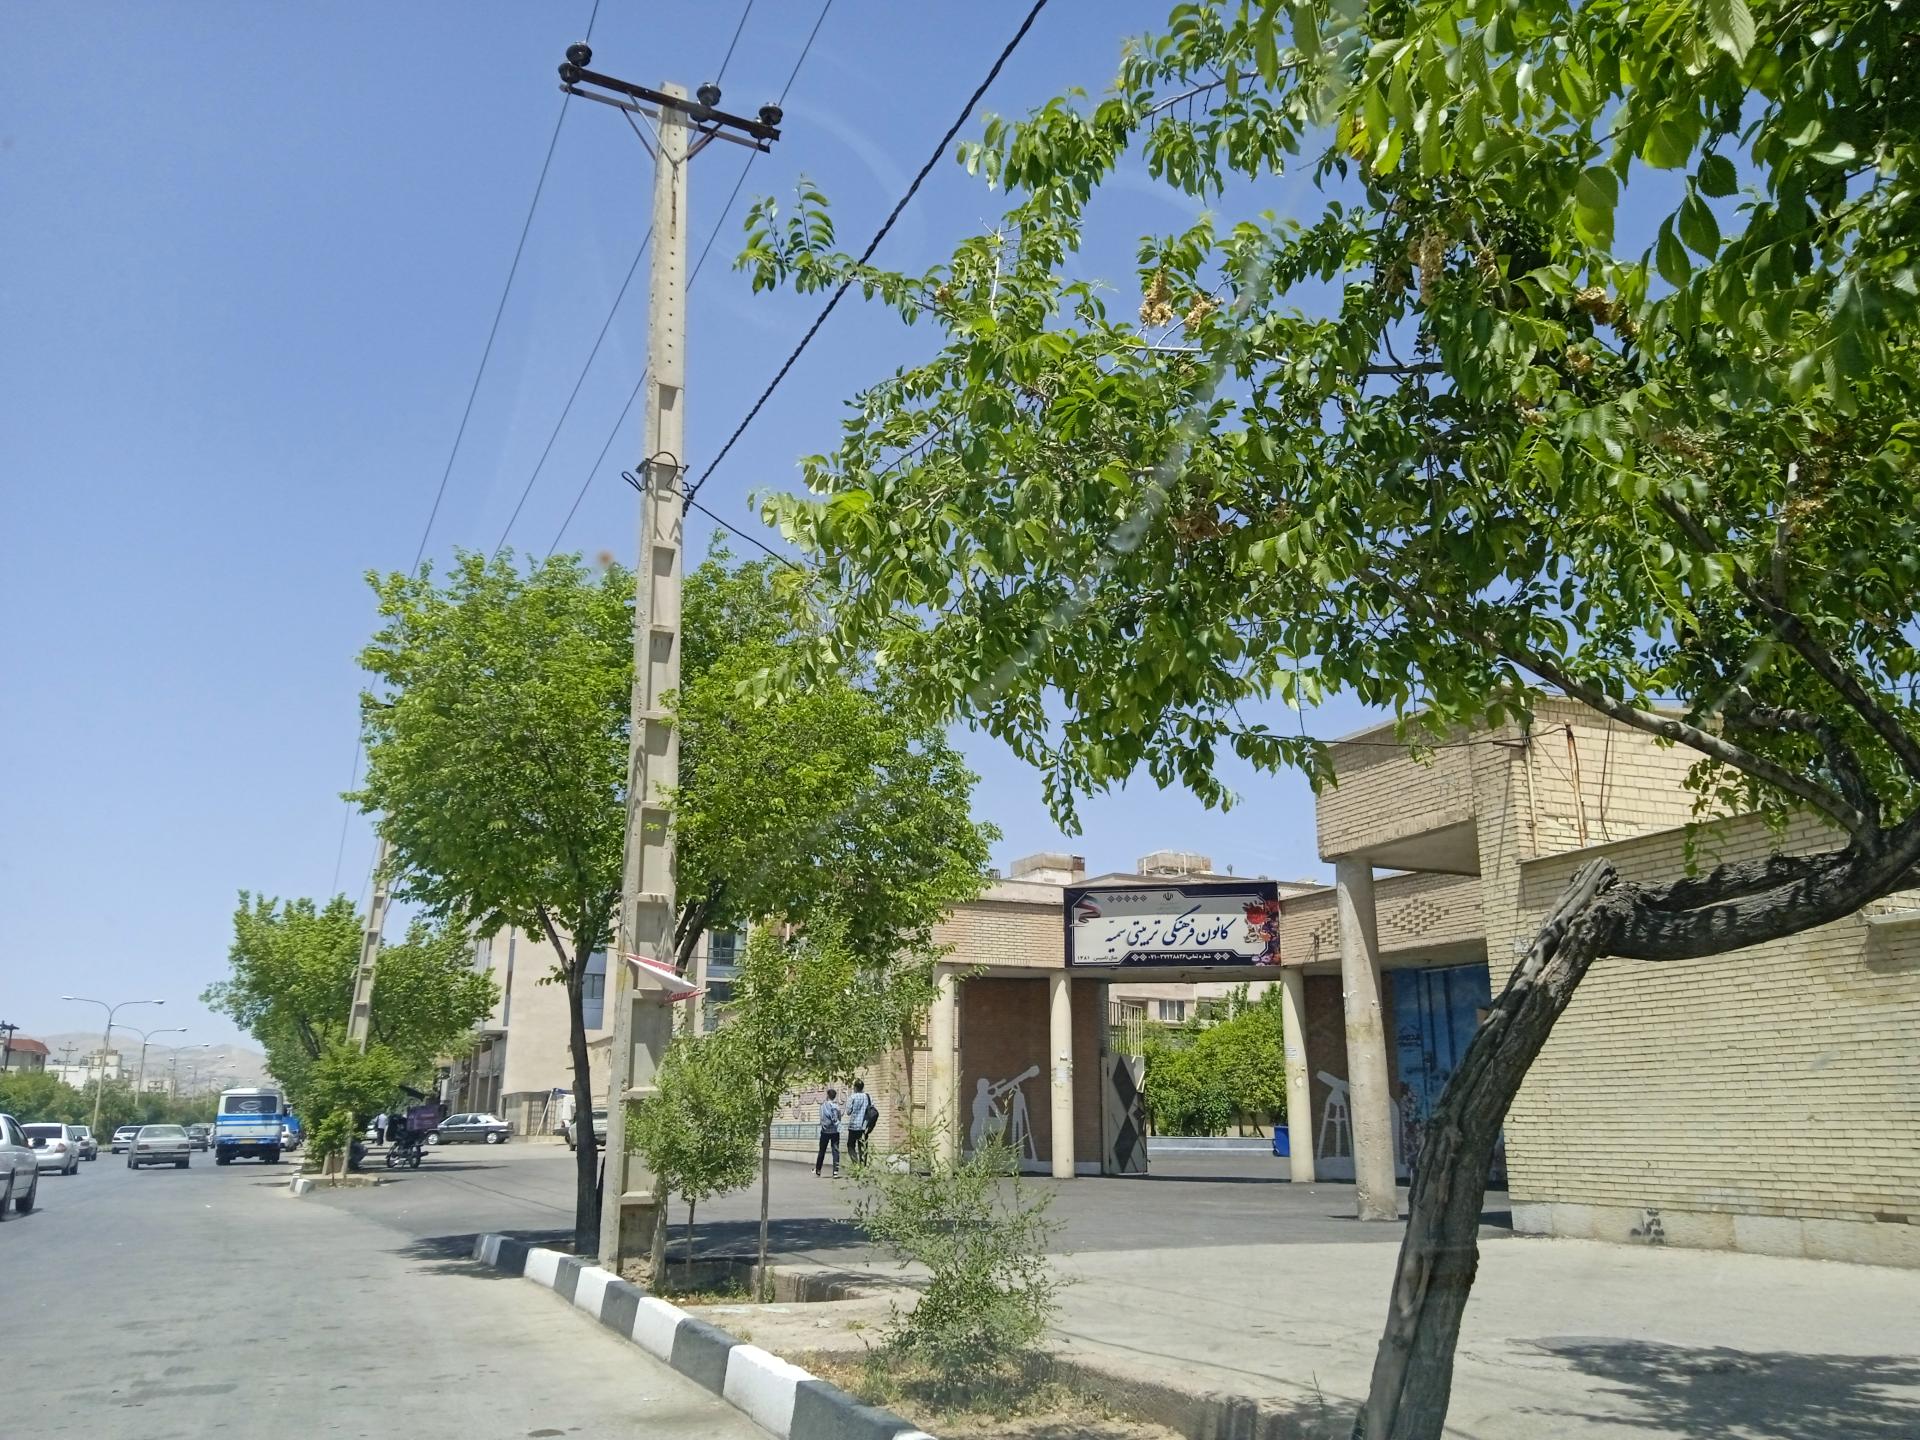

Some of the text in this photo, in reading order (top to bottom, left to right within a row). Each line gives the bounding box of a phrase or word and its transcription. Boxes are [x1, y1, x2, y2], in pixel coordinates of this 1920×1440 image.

[1126, 919, 1161, 947] تربیتی
[1161, 903, 1202, 946] فرهنگی
[1196, 916, 1237, 945] کانون
[1199, 953, 1212, 961] شماره
